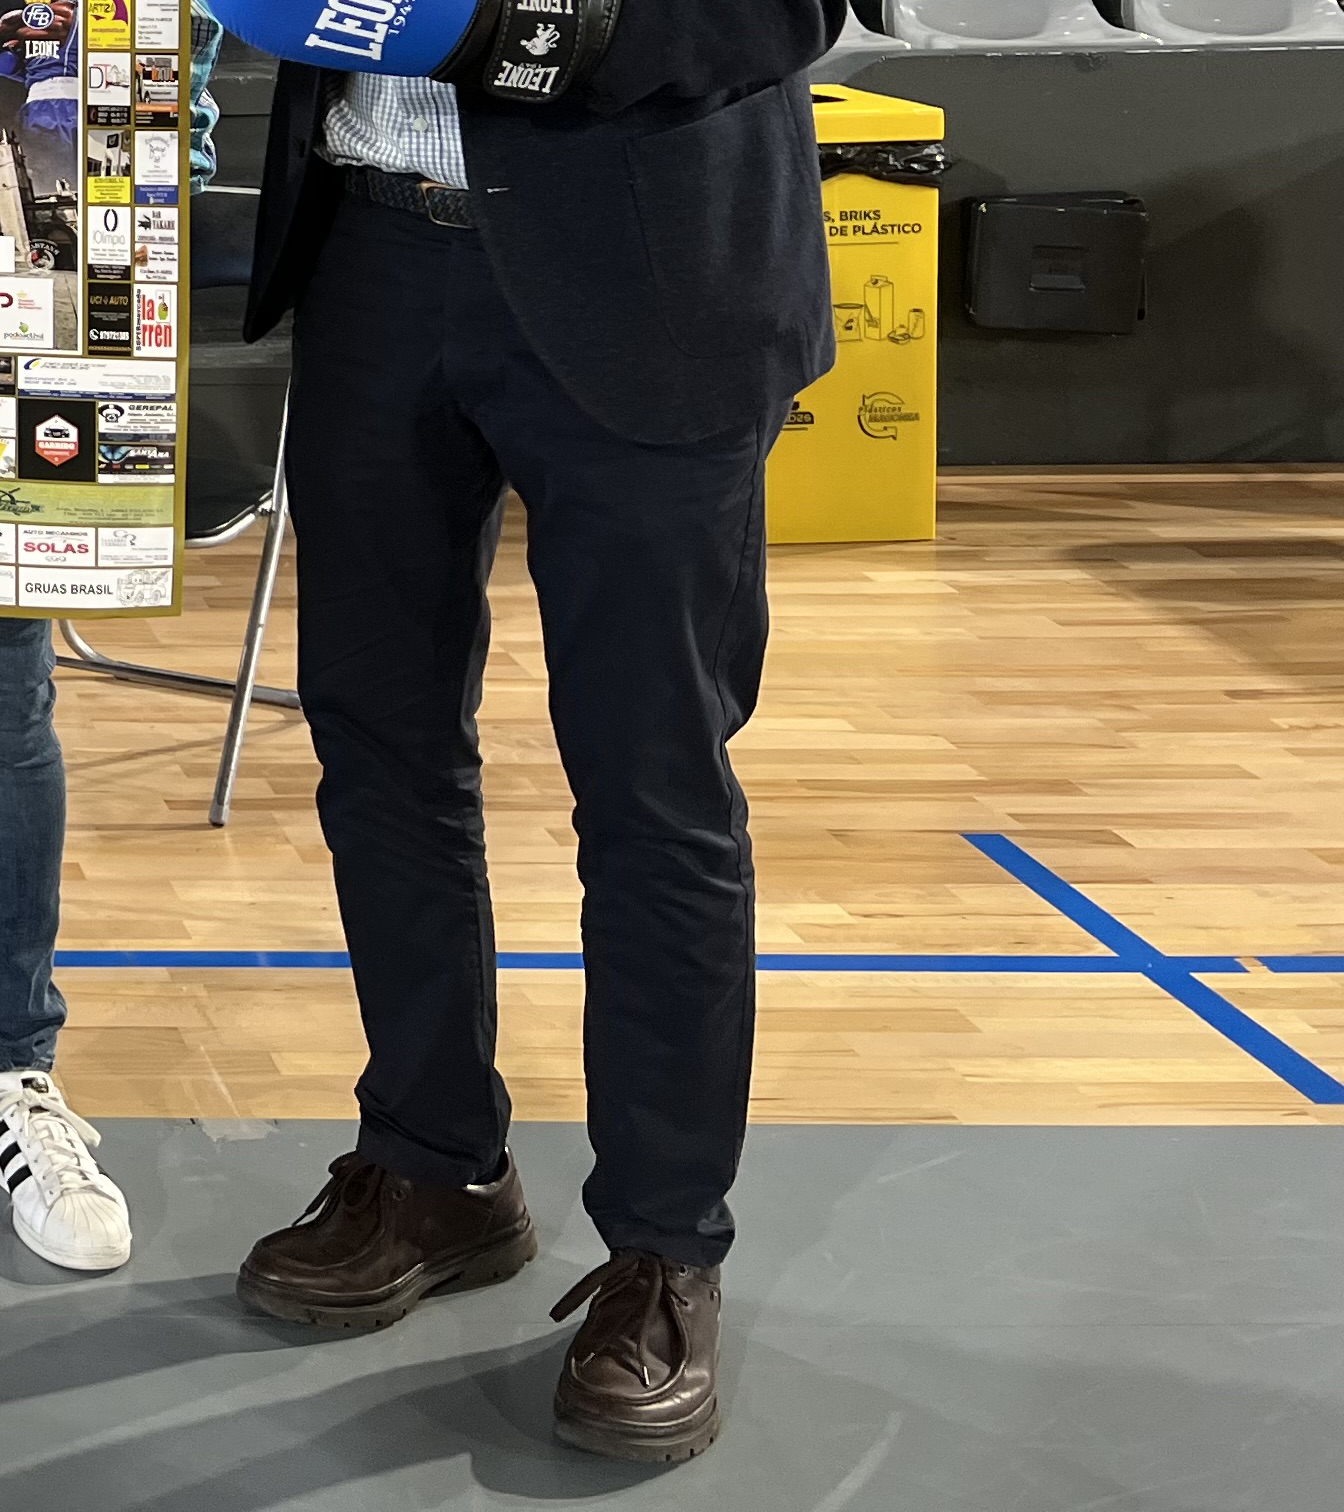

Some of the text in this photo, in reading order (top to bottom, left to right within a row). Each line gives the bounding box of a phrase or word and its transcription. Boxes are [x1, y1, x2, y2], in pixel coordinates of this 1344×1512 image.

[25, 40, 60, 59] LEONE
[494, 60, 560, 95] LEONE
[839, 209, 882, 222] BRIKS
[829, 221, 922, 237] DE PLÁSTICO
[23, 541, 89, 554] SOLAS
[24, 582, 114, 596] GRUAS BRASIL
